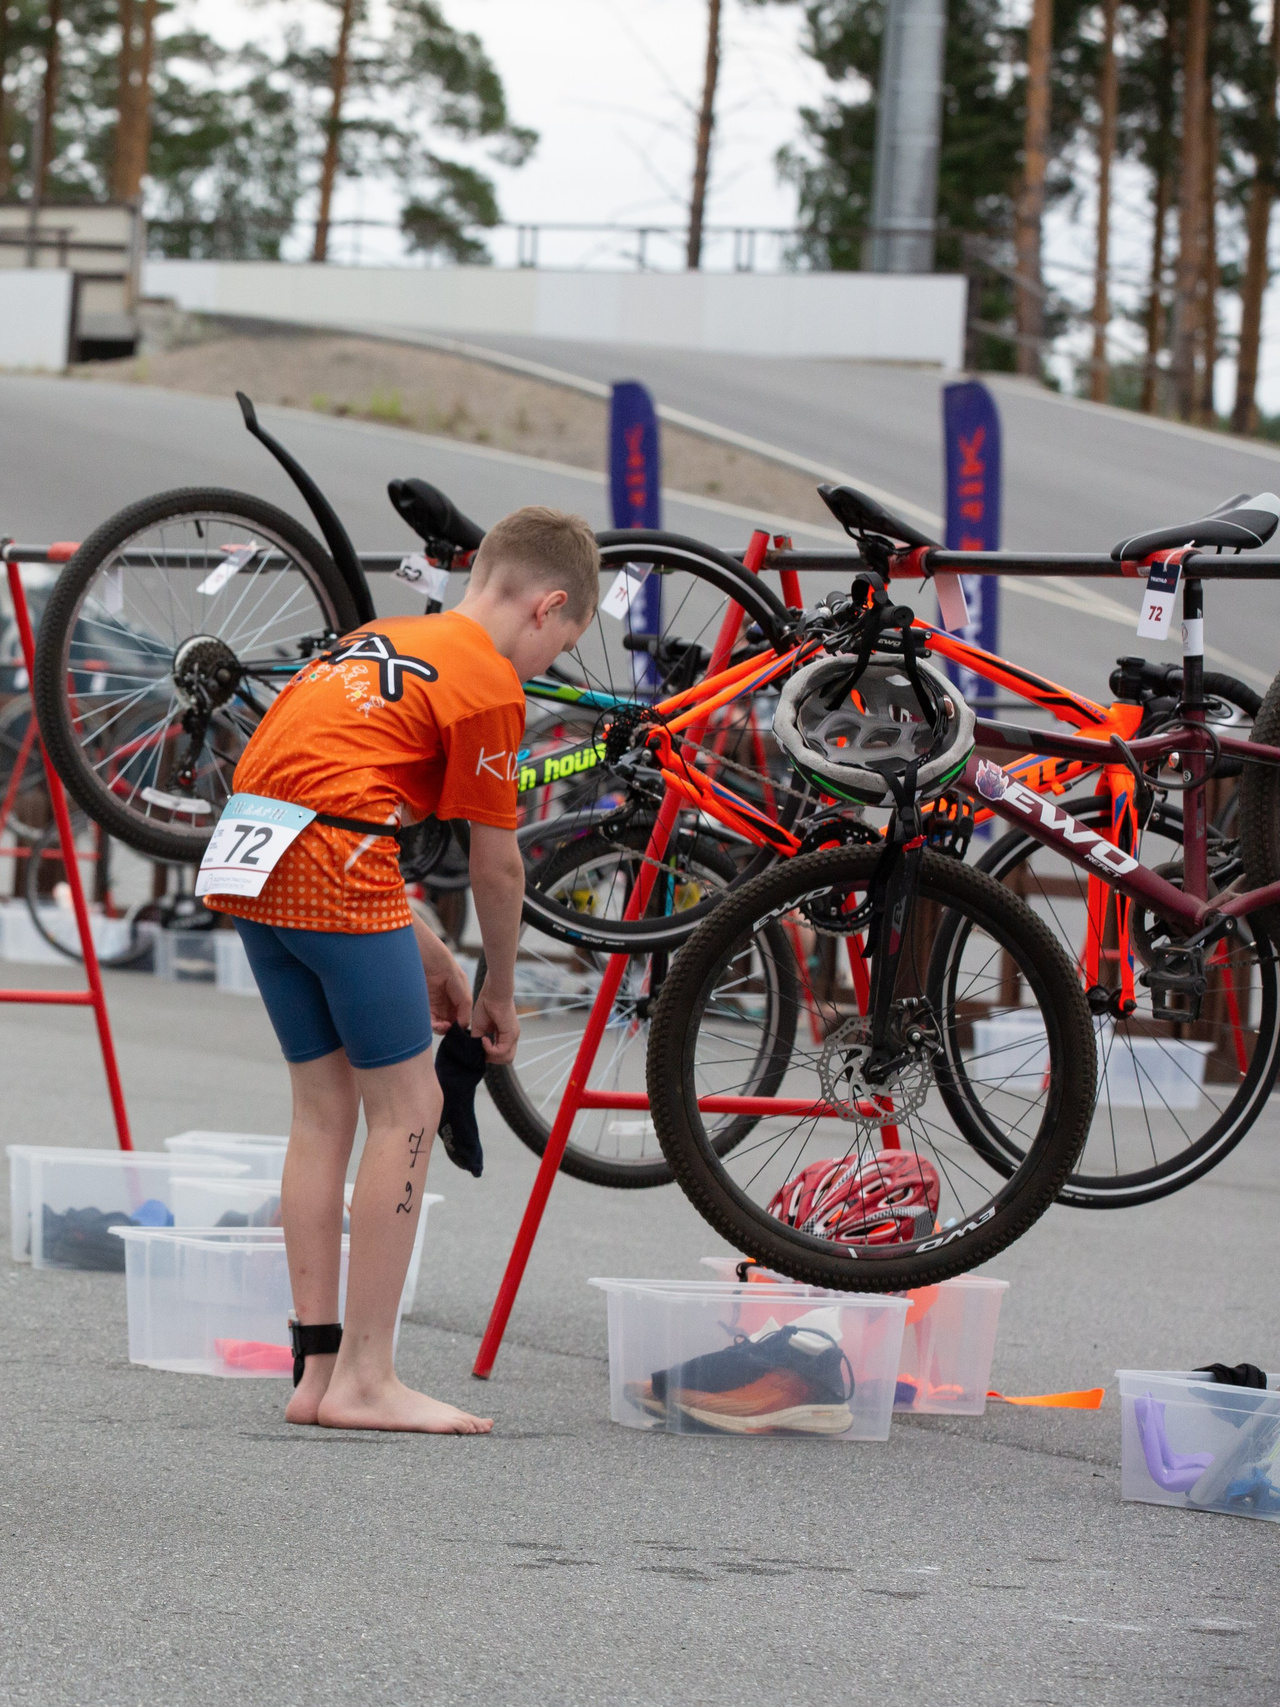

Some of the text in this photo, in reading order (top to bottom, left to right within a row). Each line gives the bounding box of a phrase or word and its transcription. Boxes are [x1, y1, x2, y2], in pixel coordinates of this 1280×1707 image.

[1148, 605, 1163, 622] 72
[224, 824, 273, 866] 72
[1002, 781, 1139, 875] EWO
[1083, 853, 1122, 878] REACT
[752, 885, 834, 933] EWO
[915, 1206, 997, 1254] EWO
